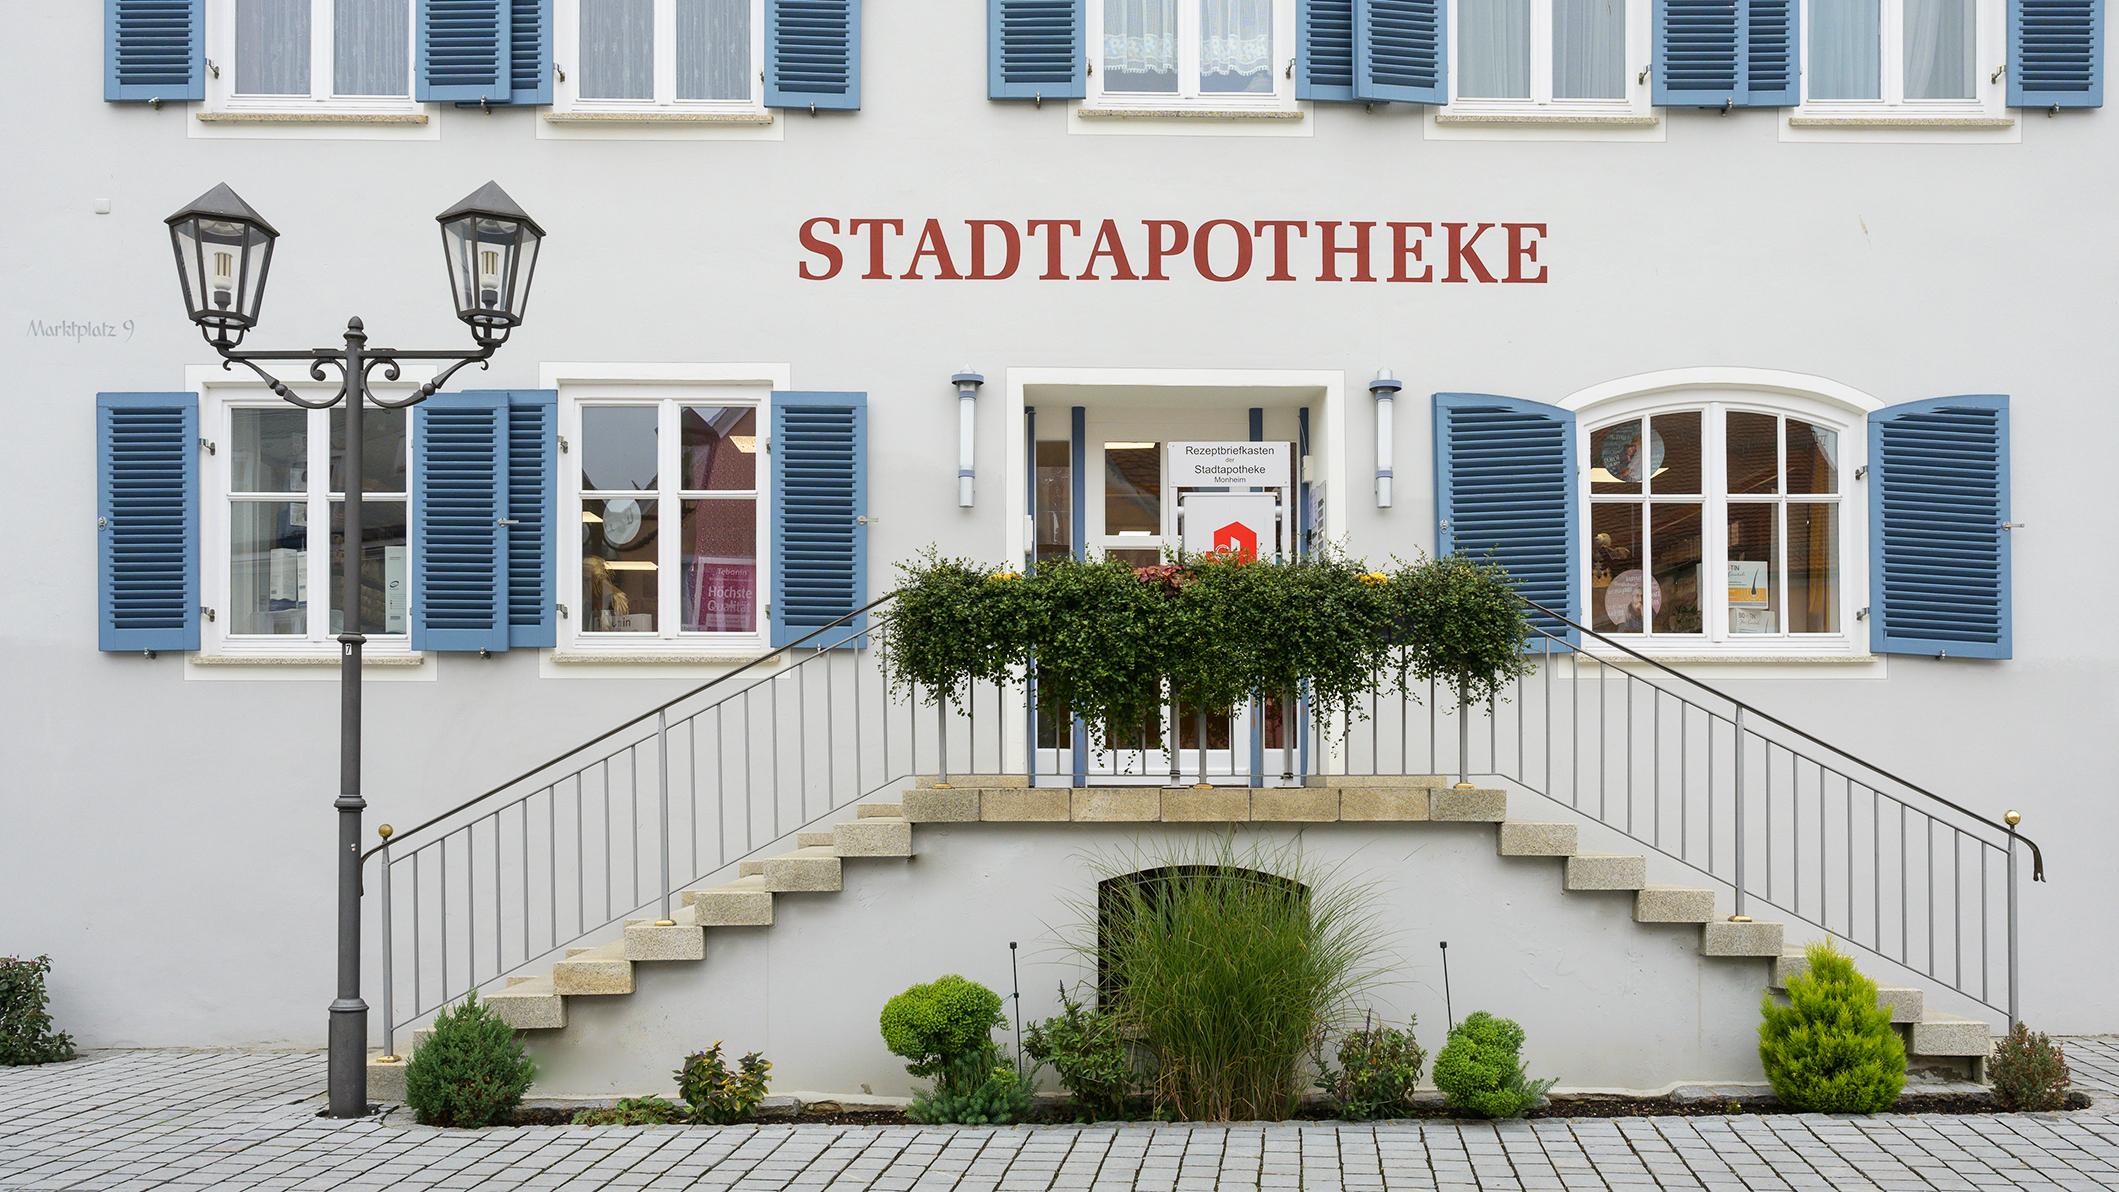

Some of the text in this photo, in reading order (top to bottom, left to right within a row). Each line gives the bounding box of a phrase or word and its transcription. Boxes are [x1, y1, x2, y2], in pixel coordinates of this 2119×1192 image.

[800, 218, 1547, 283] STADTAPOTHEKE
[27, 320, 135, 343] Marktplatz 9
[1185, 446, 1275, 456] Rezeptbriefkasten
[1194, 465, 1266, 475] Stadtapotheke
[708, 585, 753, 599] Höchste
[346, 644, 351, 654] 7
